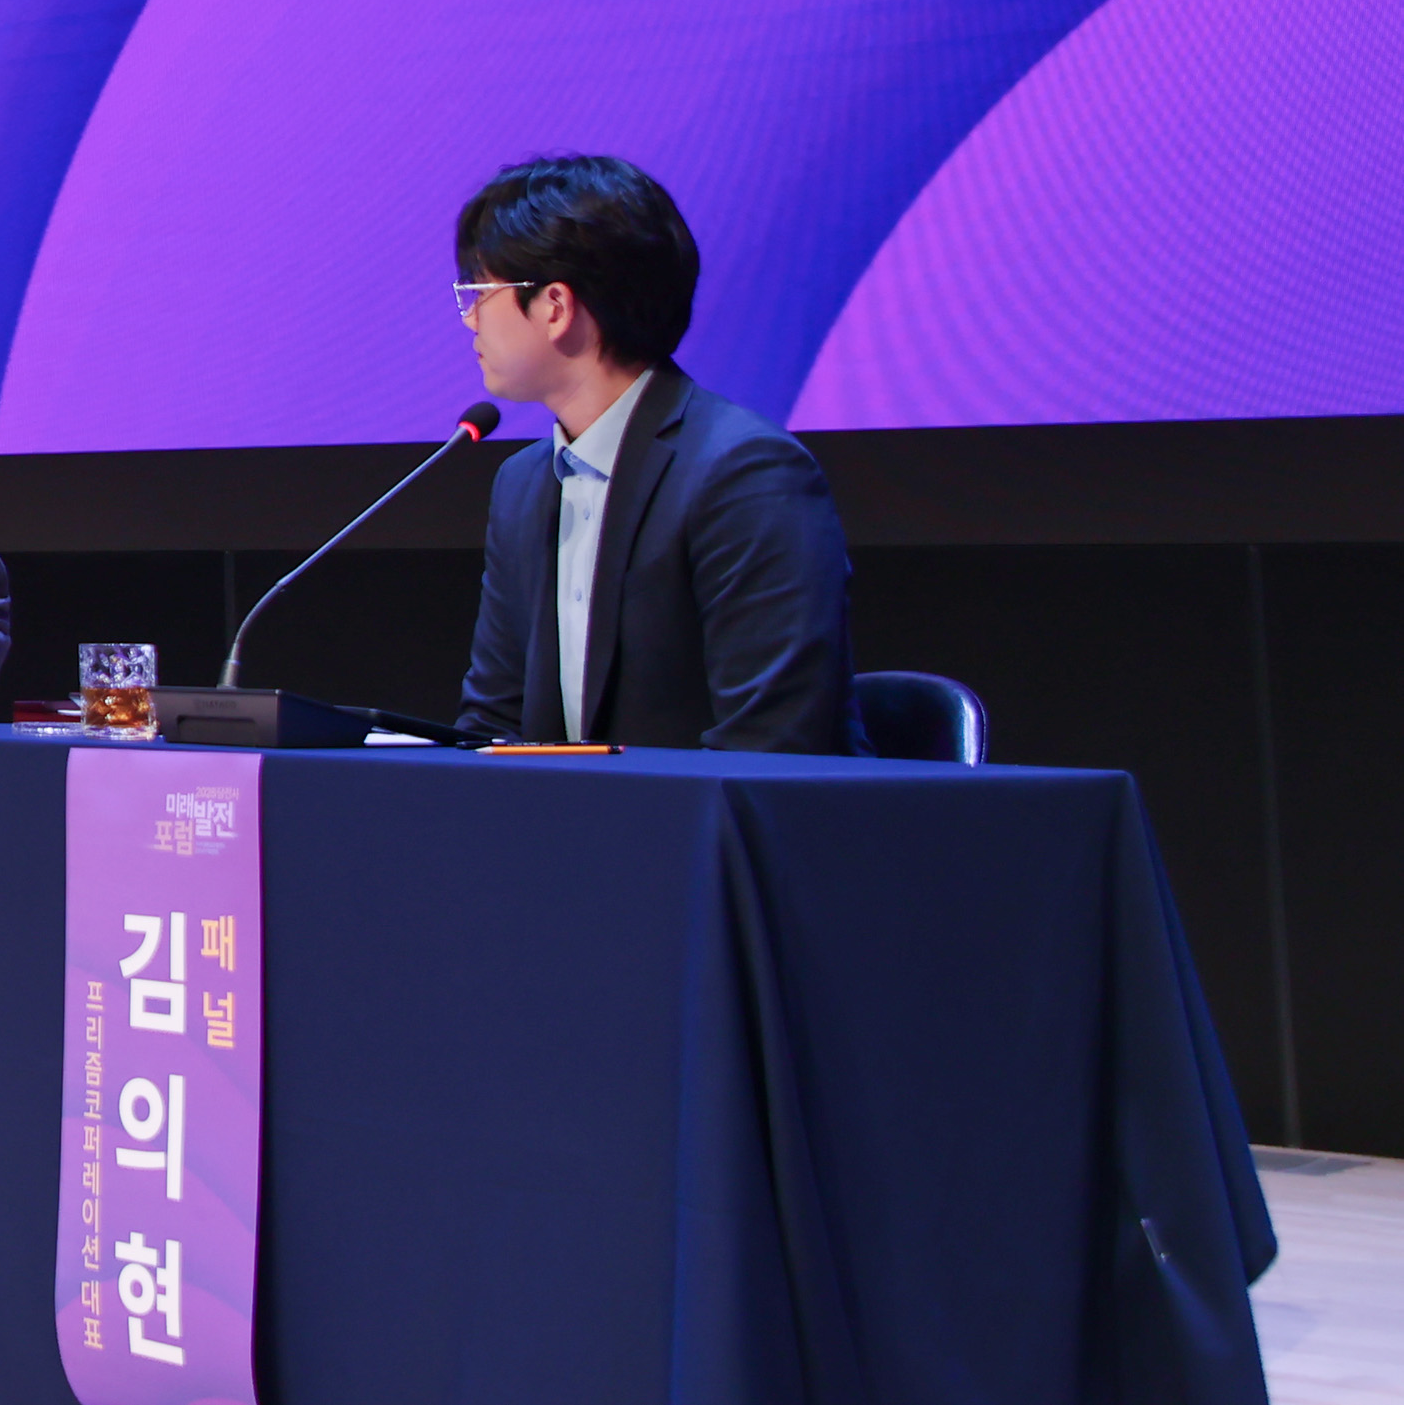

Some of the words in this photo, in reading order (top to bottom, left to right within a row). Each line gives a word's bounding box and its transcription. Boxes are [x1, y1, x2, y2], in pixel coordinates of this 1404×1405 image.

[152, 819, 194, 856] 포럼
[200, 914, 236, 1050] 패널
[80, 980, 104, 1272] 프리즘코퍼레이션
[113, 910, 188, 1368] 김의현
[80, 1279, 104, 1351] 대표
